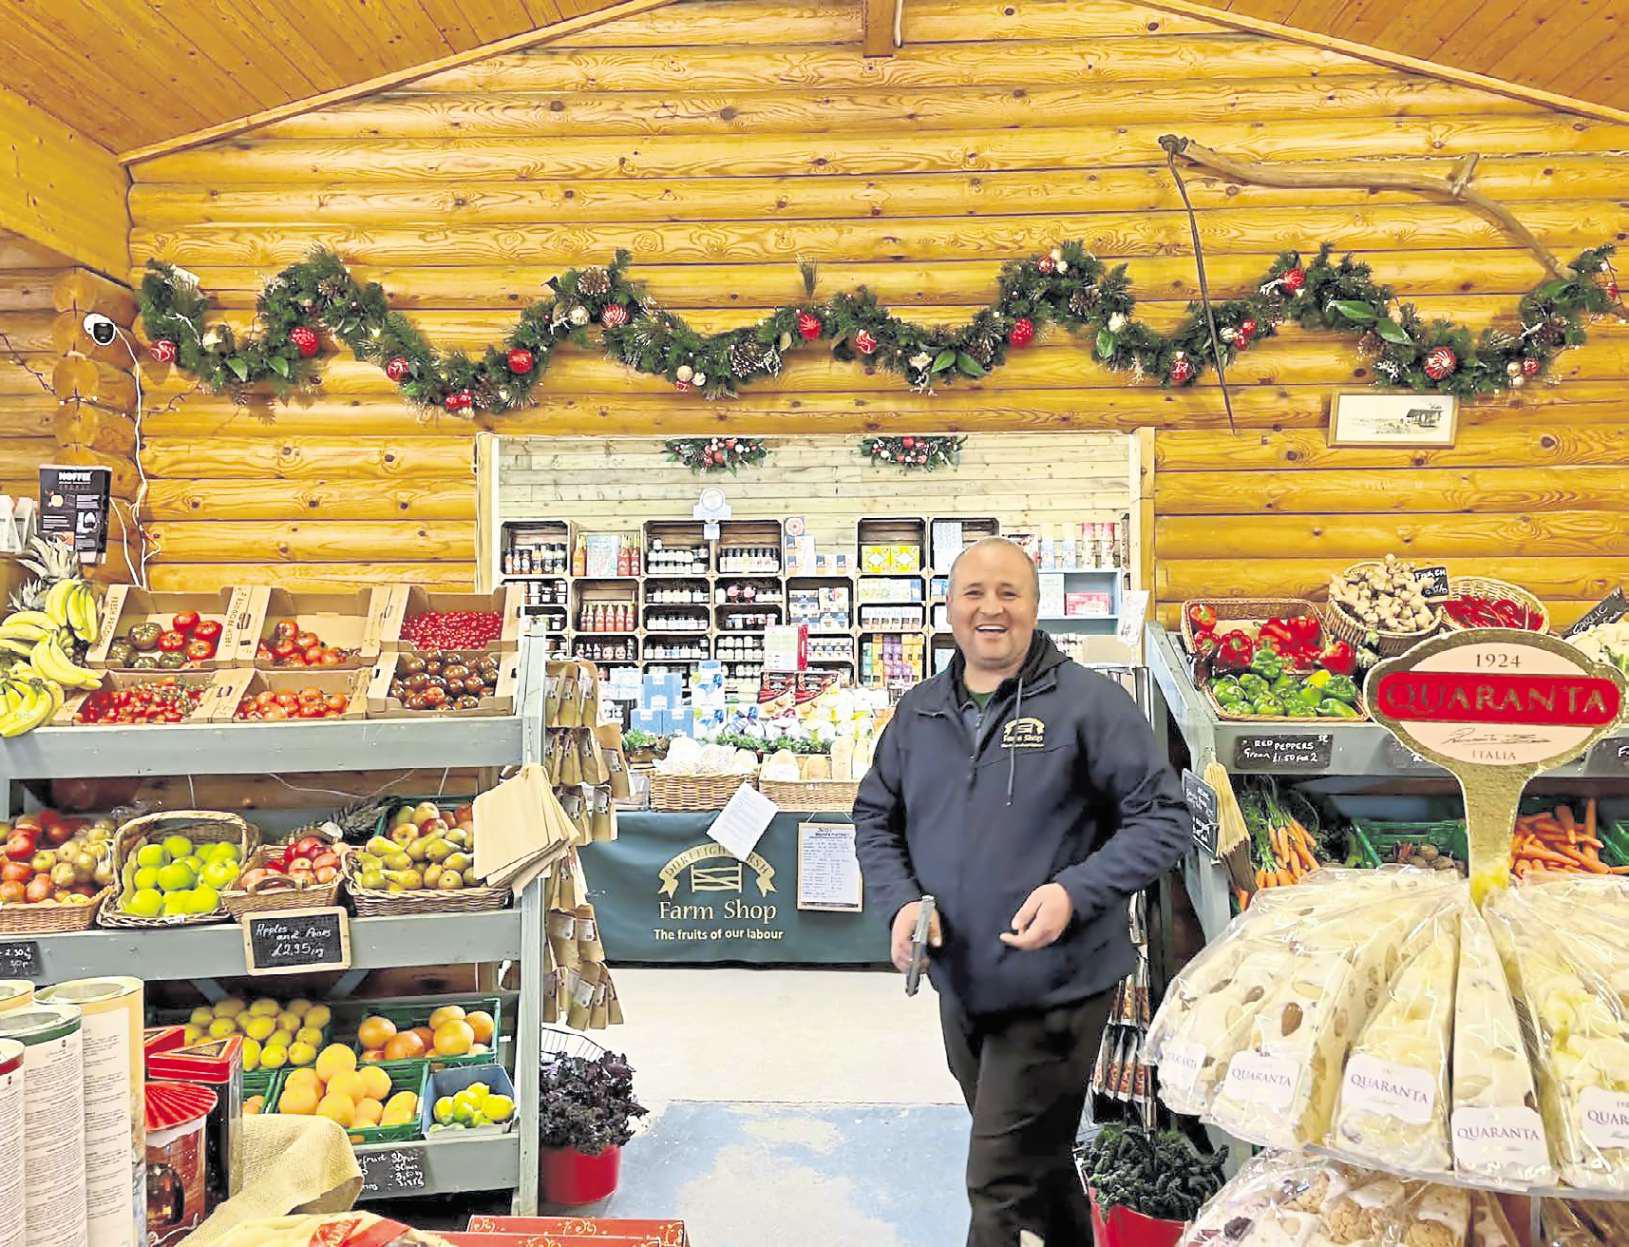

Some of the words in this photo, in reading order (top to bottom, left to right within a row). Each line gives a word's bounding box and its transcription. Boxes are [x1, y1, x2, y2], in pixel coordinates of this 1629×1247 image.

[1476, 653, 1521, 668] 1924
[1386, 682, 1607, 714] QUARANTA
[1472, 749, 1516, 761] ITALIA
[660, 901, 713, 919] Farm
[724, 899, 777, 925] Shop
[654, 929, 675, 940] The
[677, 928, 707, 940] fruits
[710, 928, 722, 940] of
[725, 928, 745, 939] our
[746, 928, 784, 940] labour
[1231, 1068, 1291, 1088] QUARANTA
[1350, 1073, 1429, 1104] QUARANTA
[1457, 1126, 1541, 1141] QUARANTA
